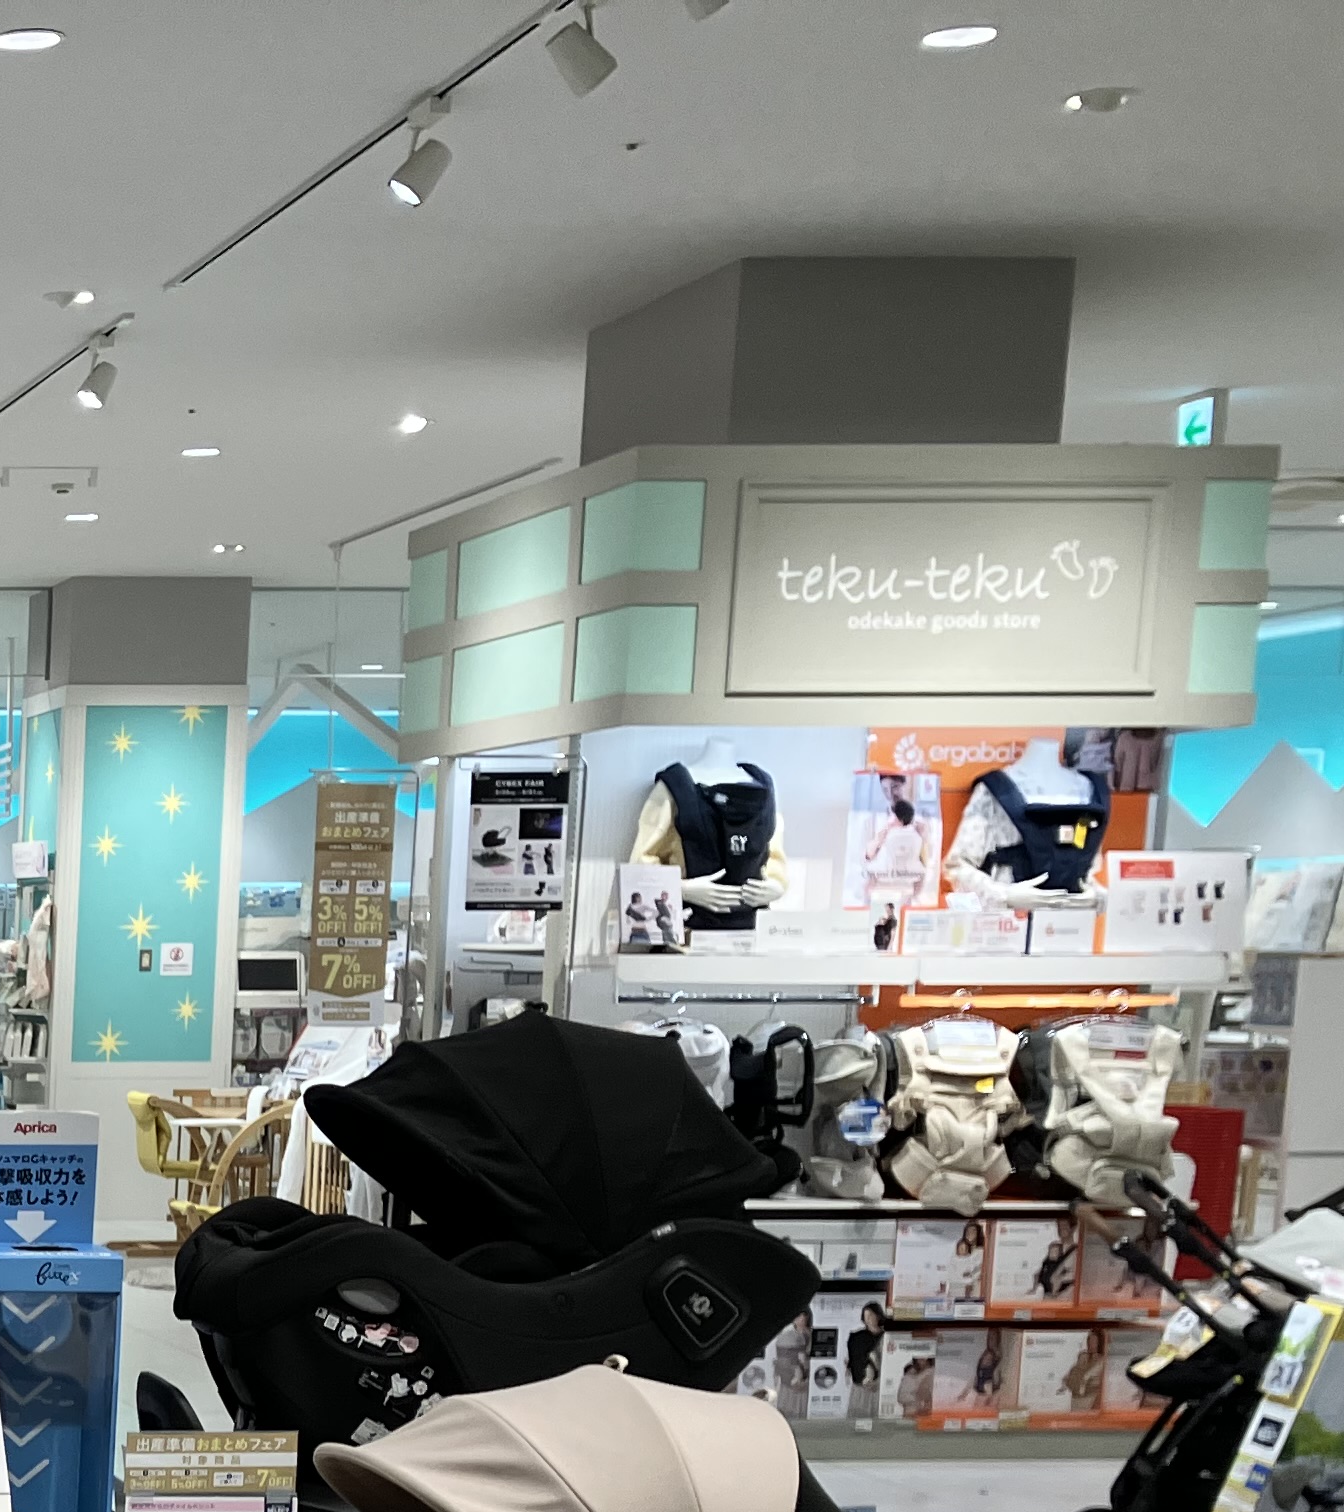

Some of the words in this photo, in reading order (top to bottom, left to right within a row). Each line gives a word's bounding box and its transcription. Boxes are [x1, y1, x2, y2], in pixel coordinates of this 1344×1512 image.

[778, 552, 1052, 604] teku-teku
[847, 611, 926, 631] odekake
[930, 611, 989, 635] goods
[993, 611, 1041, 630] store
[929, 741, 1030, 766] ergobab
[335, 812, 380, 824] 出産準備
[321, 826, 390, 839] おまとめフェア
[317, 896, 347, 922] 3%
[354, 896, 383, 921] 5%
[317, 921, 347, 934] OFF!
[353, 921, 383, 934] OFF!
[321, 954, 361, 989] 7%
[342, 974, 376, 989] OFF!
[13, 1121, 57, 1136] Aprica
[136, 1438, 287, 1452] 出産準備おまとめフェア
